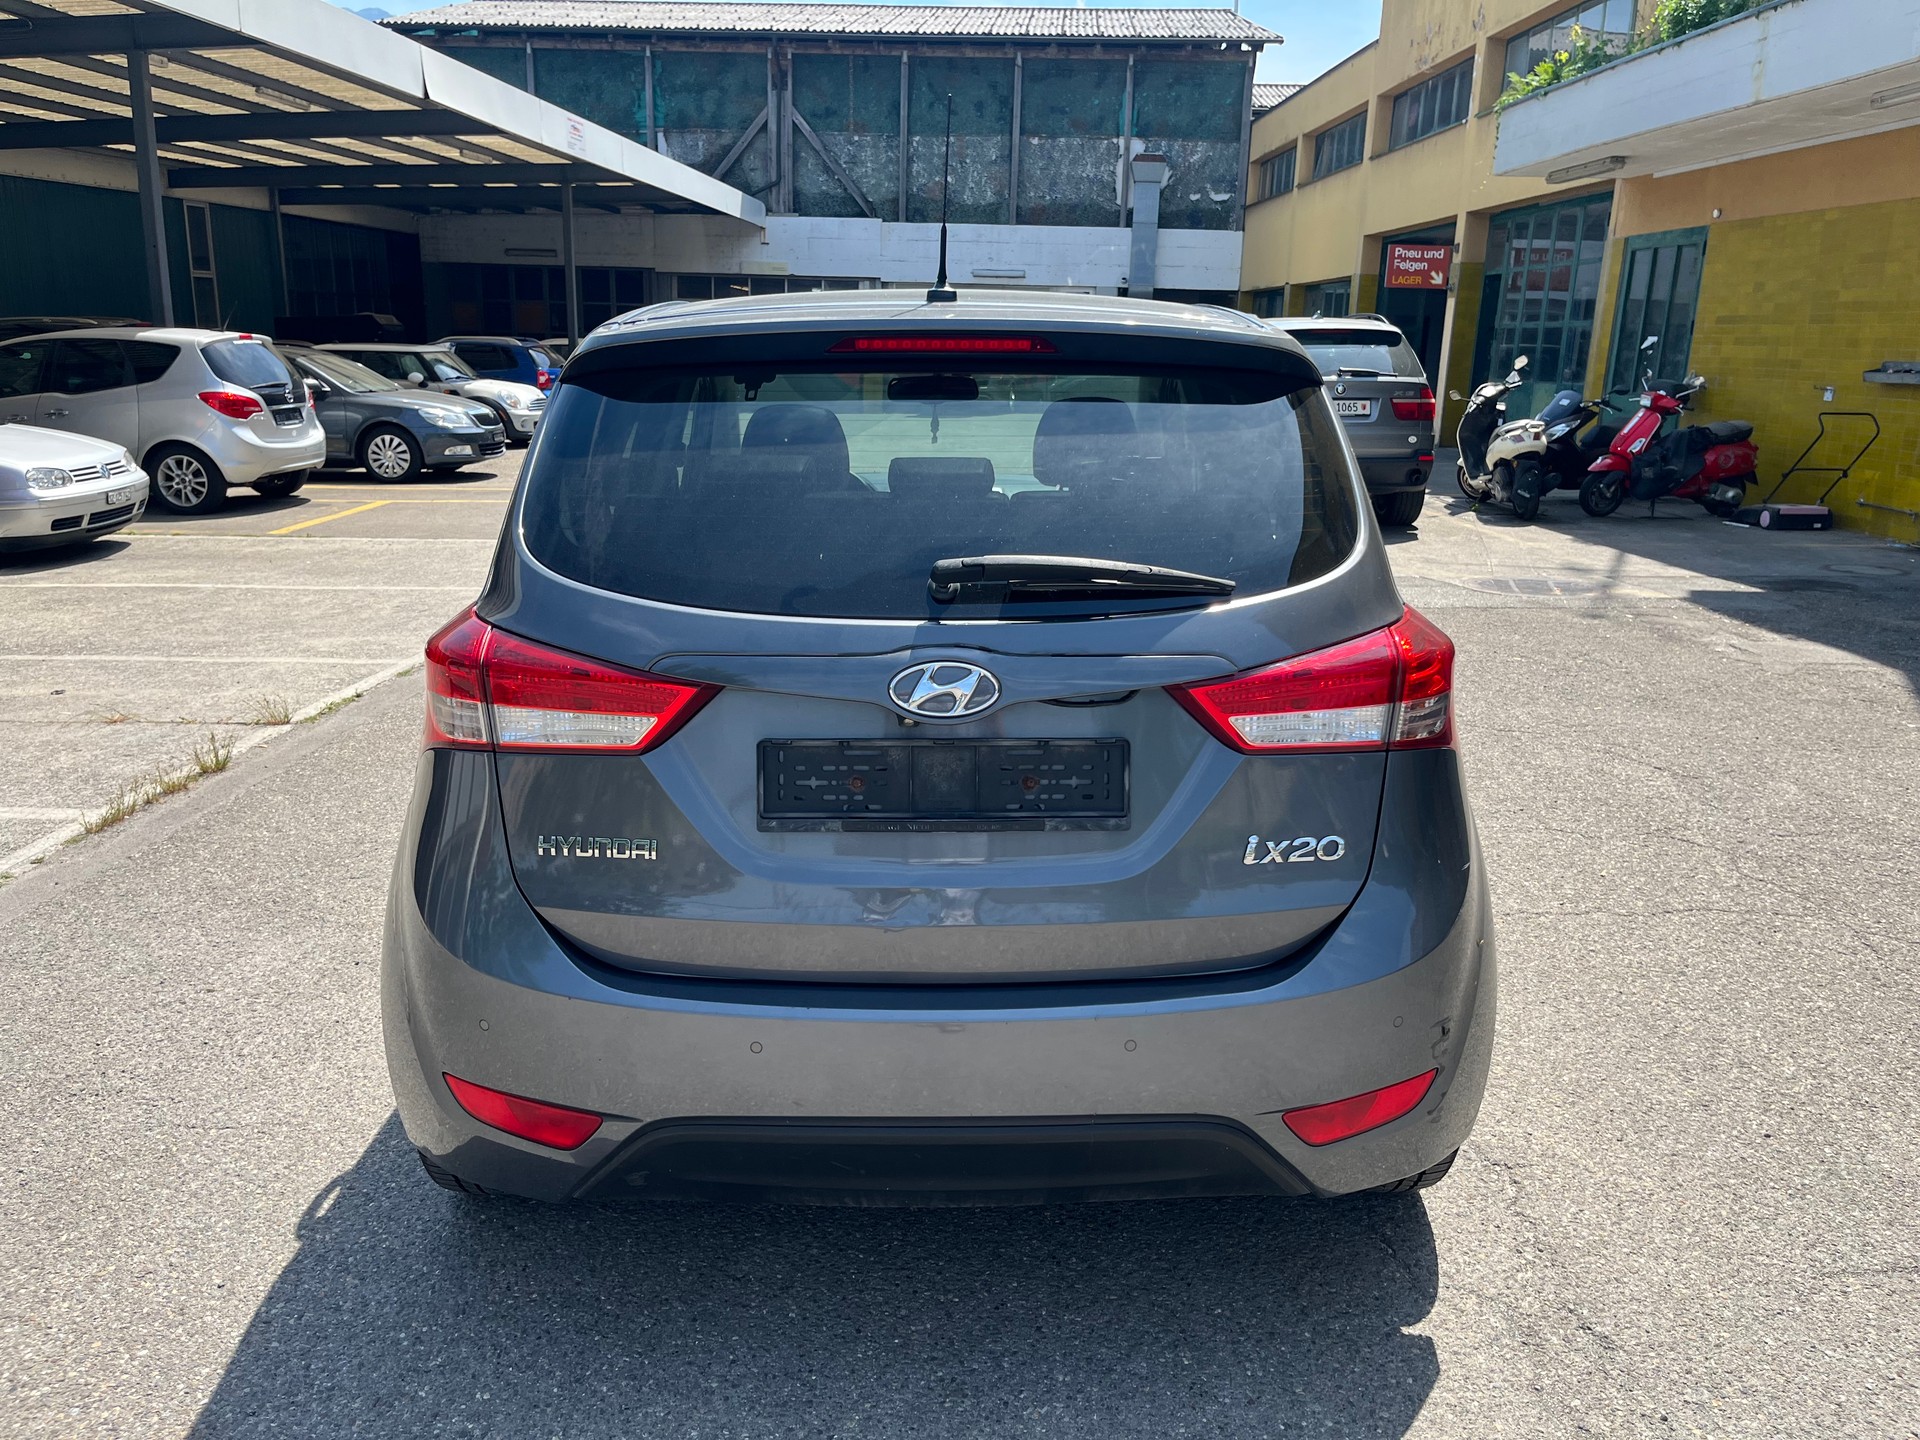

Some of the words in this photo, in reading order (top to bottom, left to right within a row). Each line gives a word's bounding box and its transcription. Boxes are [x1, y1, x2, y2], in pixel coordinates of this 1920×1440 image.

[1394, 247, 1422, 258] Pneu
[1423, 249, 1444, 259] und
[1394, 259, 1428, 272] Felgen
[1392, 275, 1422, 285] LAGER
[1336, 402, 1359, 412] 1065
[538, 835, 657, 860] HYUNDAI
[1243, 834, 1345, 865] ix20
